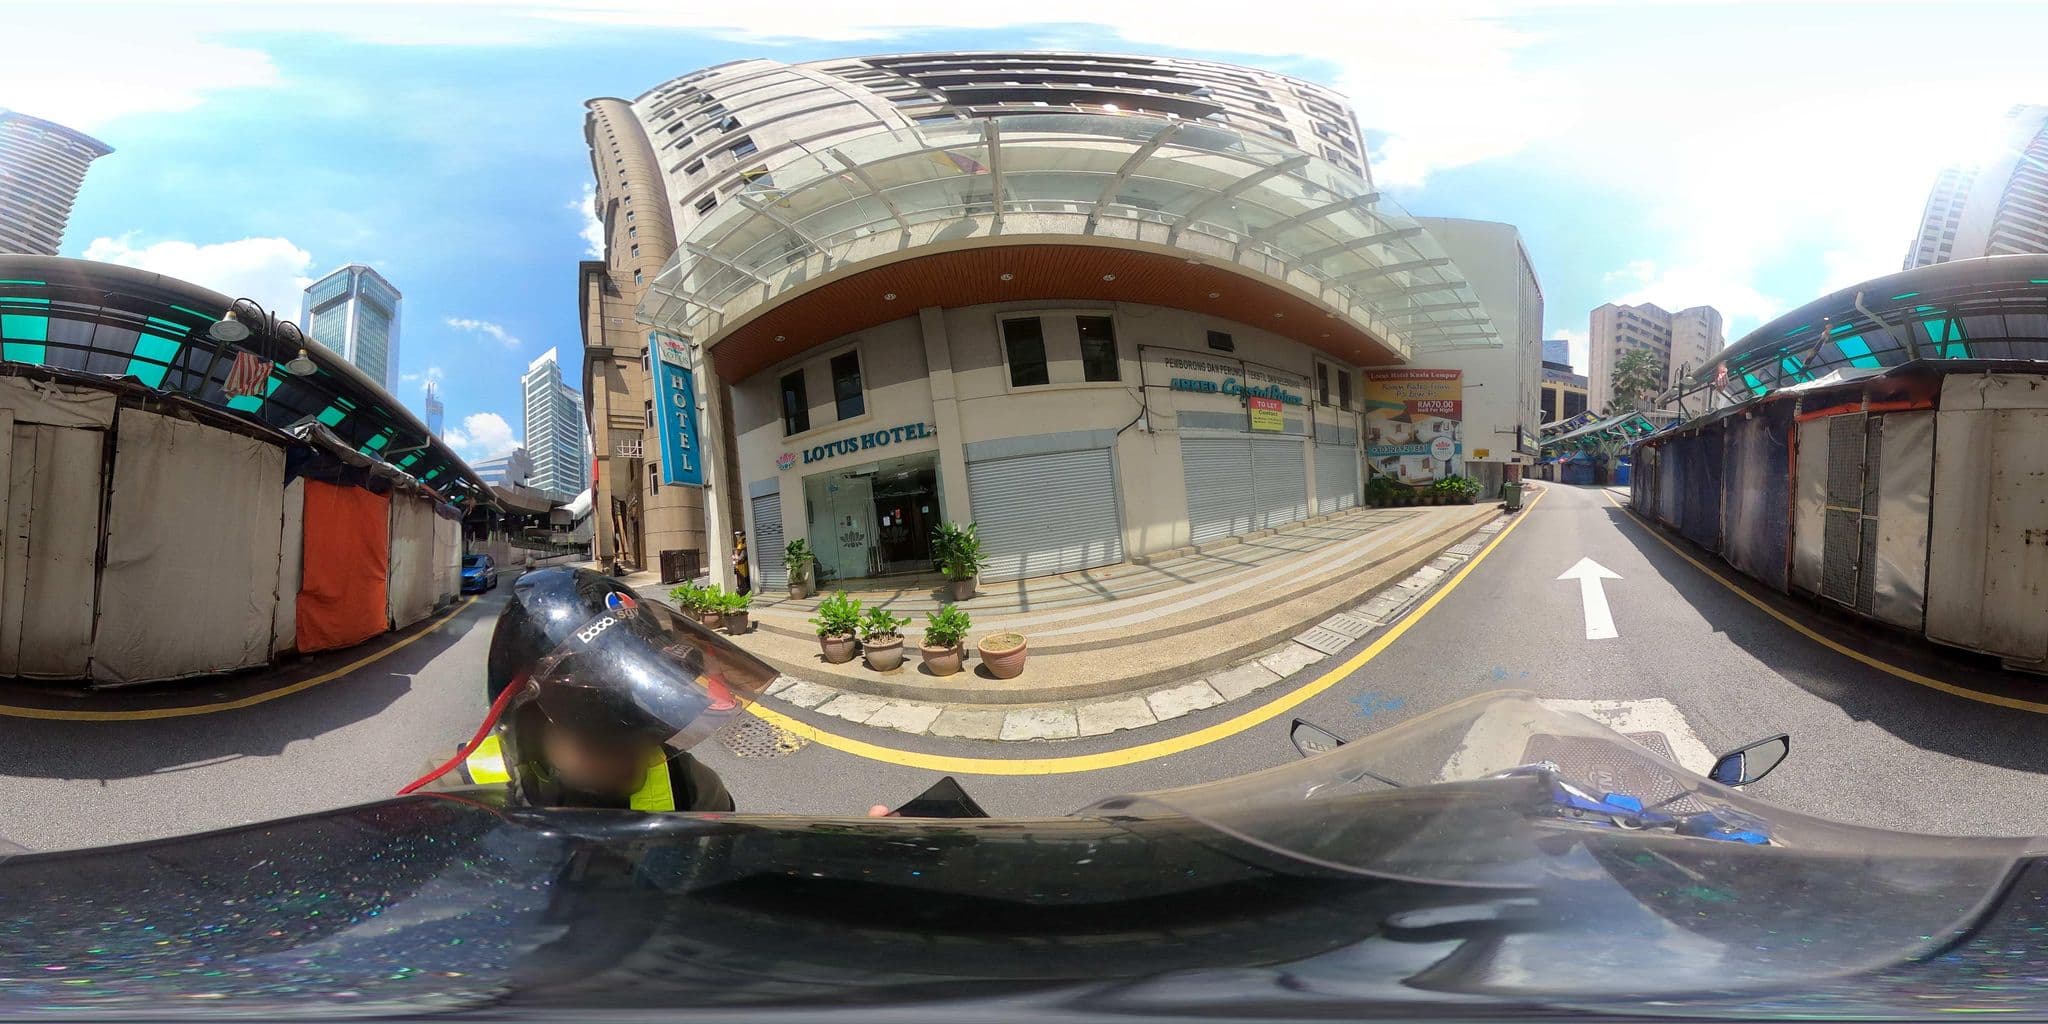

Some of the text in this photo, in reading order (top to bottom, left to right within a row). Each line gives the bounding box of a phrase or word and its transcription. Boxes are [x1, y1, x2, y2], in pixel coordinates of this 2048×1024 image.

[1430, 371, 1457, 380] Lumpur
[1256, 399, 1278, 409] TO LET
[1417, 400, 1454, 408] RM70.00
[670, 373, 693, 471] HOTEL
[803, 422, 931, 464] LOTUS HOTEL
